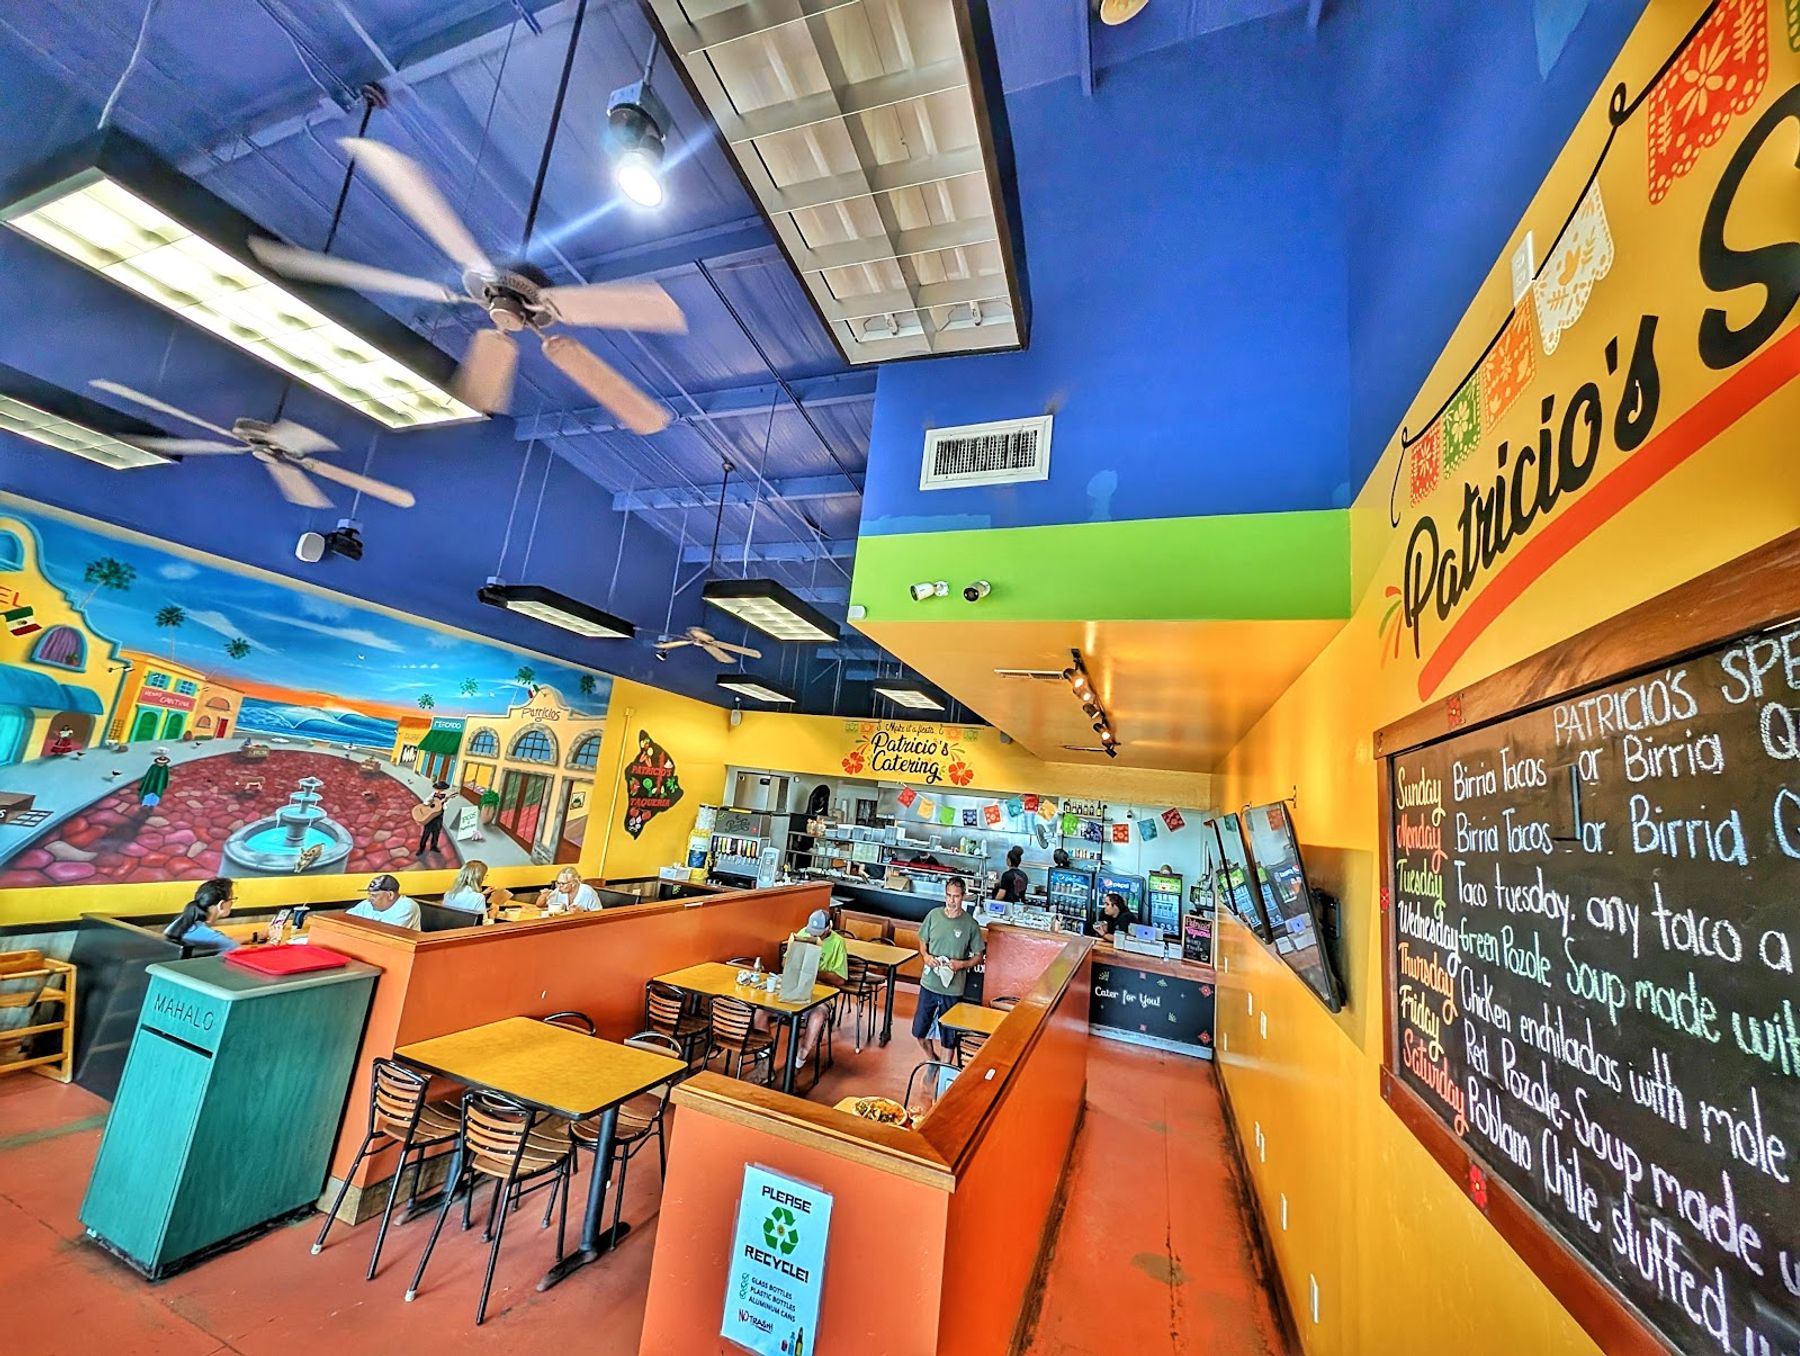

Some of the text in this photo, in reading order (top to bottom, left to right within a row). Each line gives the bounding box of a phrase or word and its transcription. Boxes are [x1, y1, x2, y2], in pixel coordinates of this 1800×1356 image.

[1404, 314, 1660, 659] Patricio's
[1554, 669, 1698, 745] PATRICIO'S
[871, 732, 949, 756] Patricio's
[872, 750, 942, 784] Catering
[1397, 767, 1446, 826] Sunday
[1453, 761, 1496, 801] Birria
[1500, 748, 1546, 787] Tacos
[1578, 748, 1603, 782] or
[1623, 730, 1723, 782] Birria
[1397, 813, 1448, 873] Monday
[1456, 812, 1498, 853] Birria
[1502, 808, 1553, 854] Tacos
[1630, 794, 1749, 866] Birria
[1397, 859, 1447, 920] Tuesday
[1454, 860, 1487, 907] Taco
[1586, 895, 1640, 959] any
[1651, 882, 1742, 964] taco
[1398, 900, 1461, 977] Wednesday
[1459, 916, 1500, 966] Green
[1501, 925, 1551, 988] Pozole
[1565, 937, 1626, 1026] Soup
[1635, 971, 1720, 1043] made
[154, 993, 214, 1031] MAHALO
[1095, 986, 1160, 1008] Cater for You!
[1398, 942, 1790, 1183] Thursday Chicken enchiladas with mole
[1399, 985, 1444, 1062] Friday
[1464, 1018, 1489, 1077] Red
[1651, 1163, 1763, 1276] made
[762, 1185, 812, 1214] PLEASE
[1404, 1028, 1469, 1137] Saturday
[1467, 1076, 1532, 1171] Poblano
[1542, 1129, 1601, 1233] Chile
[1612, 1192, 1731, 1354] stuffed
[744, 1244, 809, 1283] RECYCLE!
[751, 1286, 795, 1312] PLASTIC BOTTLES
[752, 1277, 792, 1299] GLASS BOTTLES
[739, 1308, 749, 1322] NO
[749, 1296, 795, 1322] ALUMINUM CANS
